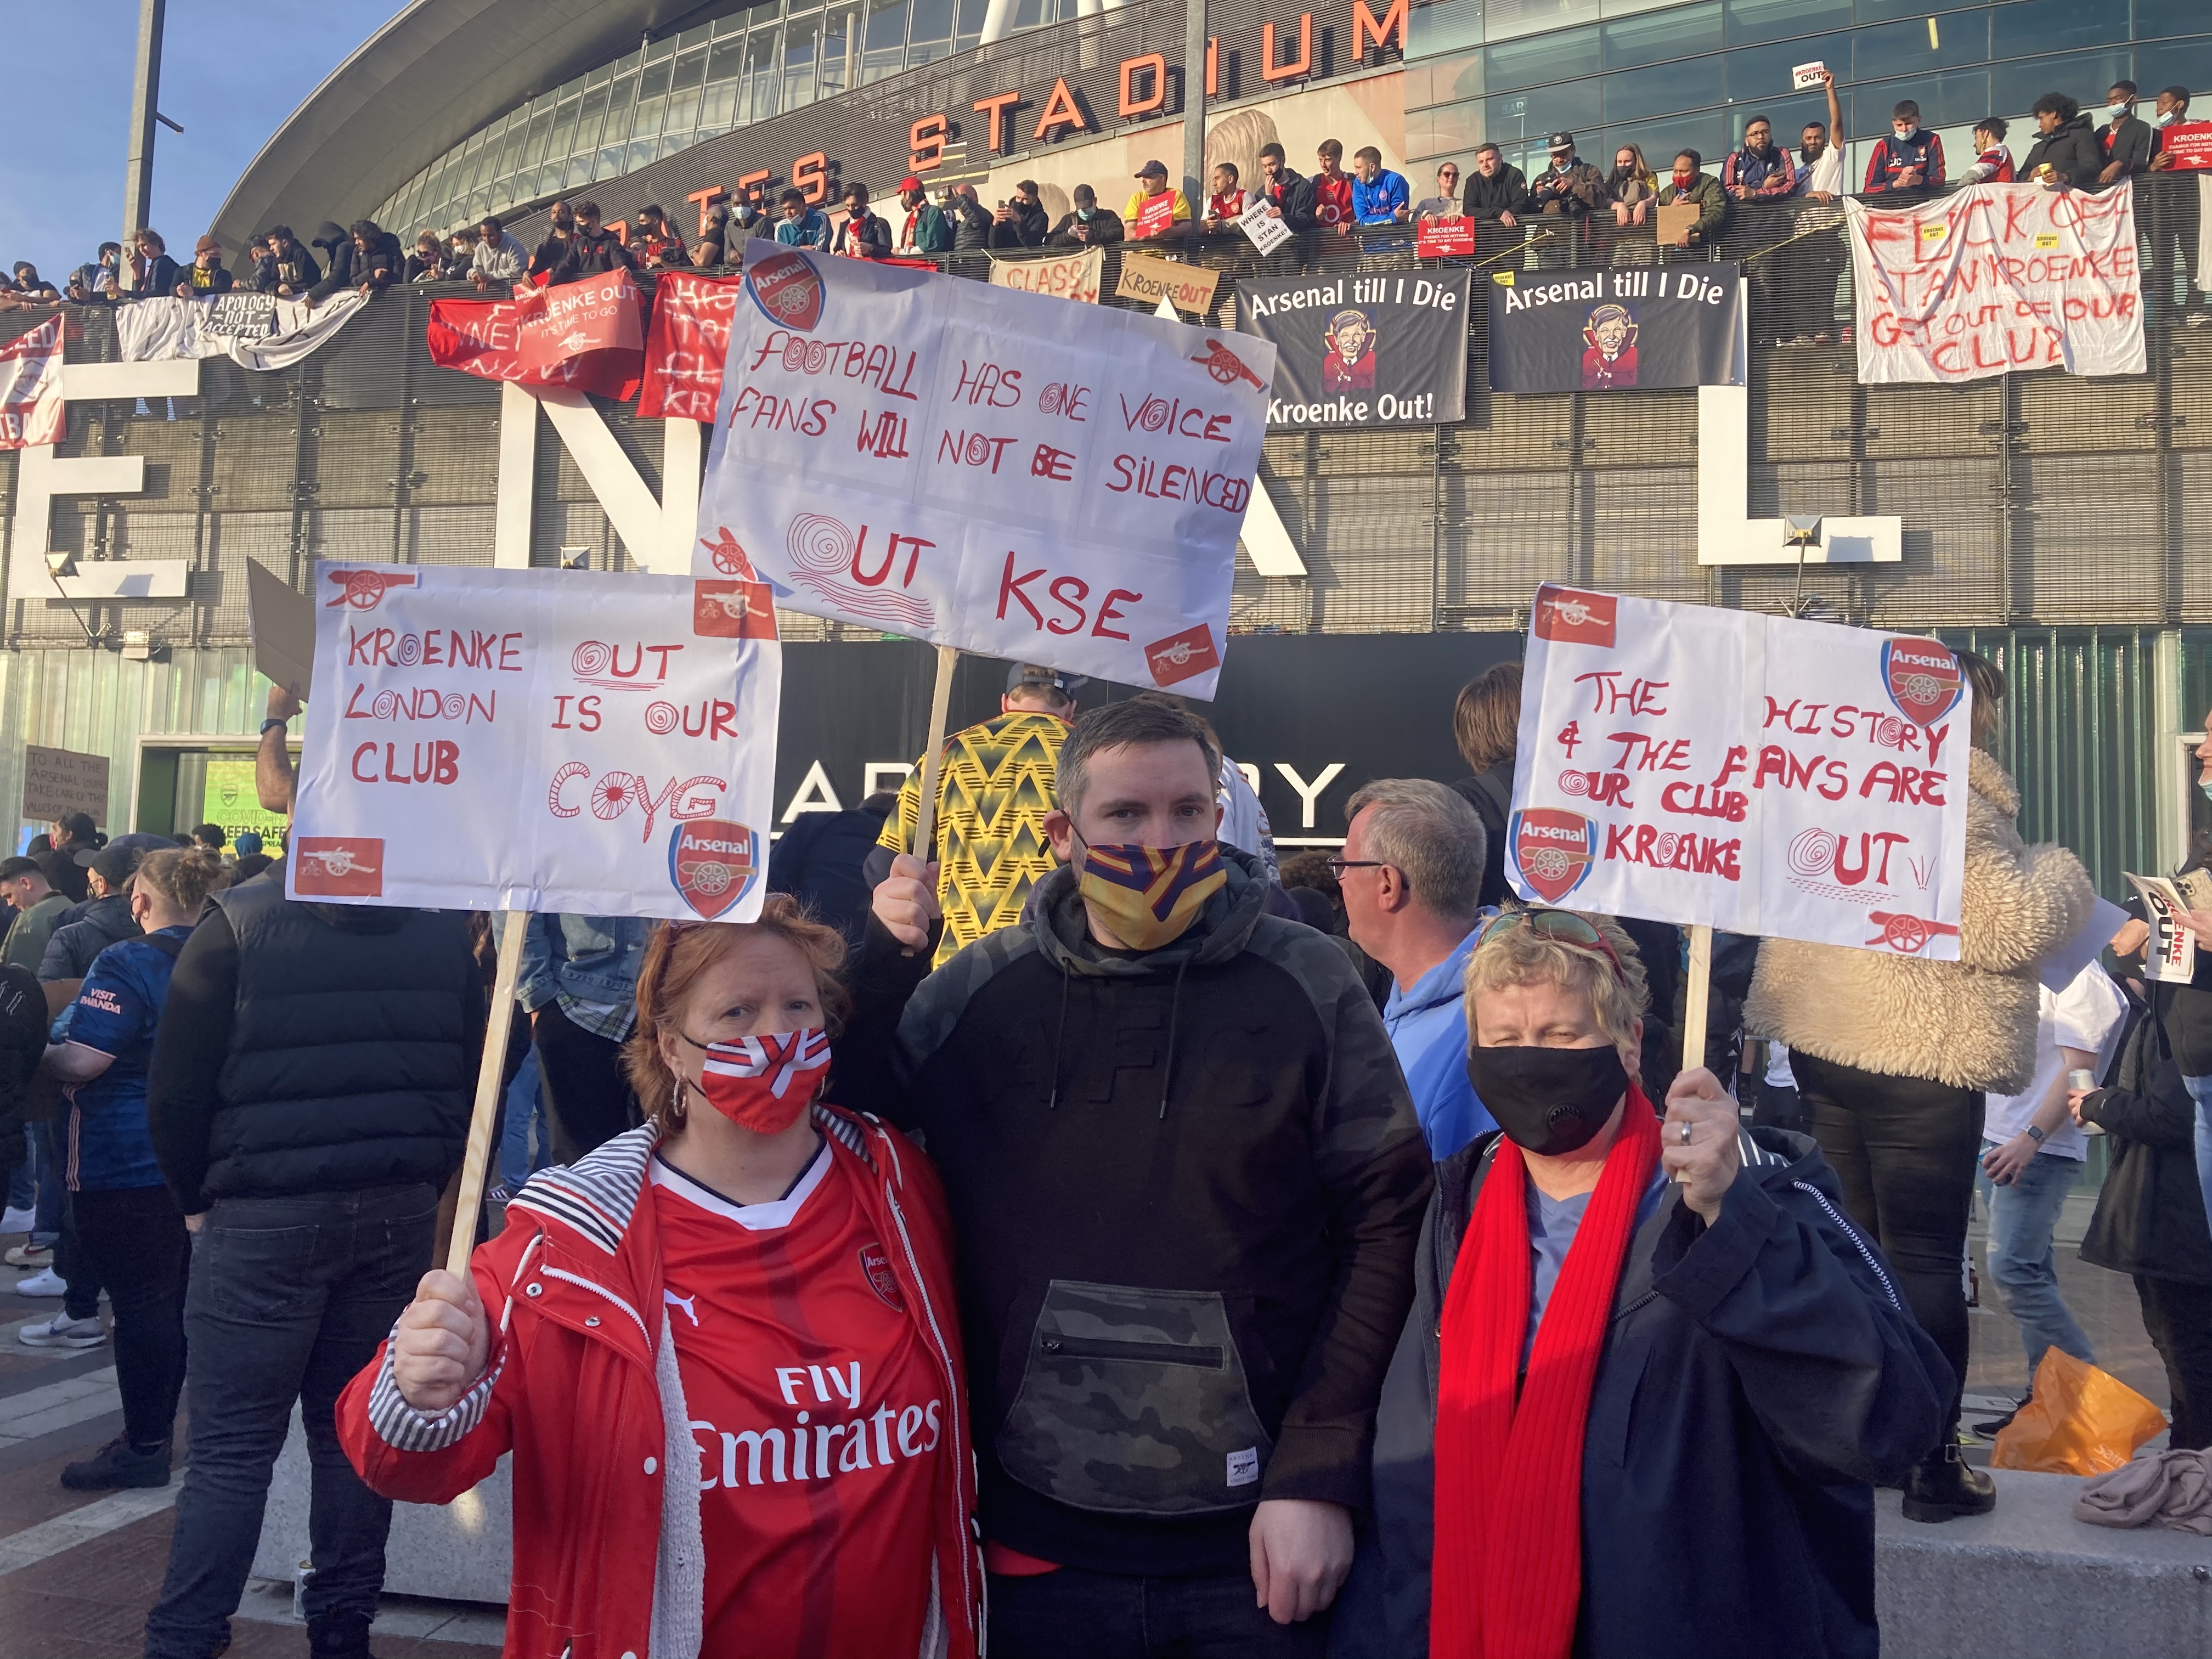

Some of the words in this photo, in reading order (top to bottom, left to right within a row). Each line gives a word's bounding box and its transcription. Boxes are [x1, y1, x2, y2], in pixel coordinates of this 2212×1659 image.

[909, 0, 1410, 172] STADIUM
[1801, 71, 1821, 82] OUT
[1145, 200, 1169, 215] KROENKE
[1240, 204, 1268, 227] WHERE
[1256, 221, 1266, 229] IS
[1257, 223, 1278, 241] STAN
[1259, 228, 1288, 252] KROENKE?
[1867, 195, 2036, 264] FUCK
[2050, 189, 2130, 238] OFF
[755, 259, 806, 291] Arsenal
[1007, 261, 1082, 293] CLASS
[1874, 259, 1979, 307] STAN
[1988, 246, 2134, 287] KROENKE
[215, 295, 275, 312] APOLOGY
[521, 291, 596, 328] KROENKE
[601, 285, 636, 301] OUT
[1252, 279, 1344, 320] Arsenal
[1353, 278, 1385, 303] till
[1396, 278, 1403, 304] I
[1412, 280, 1456, 311] Die
[1505, 273, 1603, 314] Arsenal
[1613, 271, 1648, 297] till
[1658, 272, 1667, 297] I
[1677, 273, 1724, 304] Die
[203, 321, 269, 336] ACCEPTED
[224, 310, 256, 324] NOT
[541, 324, 558, 338] IT'S
[558, 314, 580, 330] TIME
[582, 310, 597, 321] TO
[600, 305, 618, 317] GO
[1871, 312, 1937, 347] GET
[1944, 305, 2002, 335] OUT
[2016, 301, 2051, 319] OF
[2063, 293, 2136, 321] OUR
[1933, 325, 2064, 373] CLUB
[751, 330, 918, 401] FOOTBALL
[952, 359, 1022, 408] HAS
[1039, 382, 1092, 422] ONE
[1119, 392, 1232, 442] VOICE
[1265, 396, 1368, 424] Kroenke
[1378, 392, 1433, 421] Out!
[729, 386, 836, 437] FANS
[857, 409, 909, 458] WILL
[938, 430, 1019, 475] NOT
[1032, 443, 1076, 482] BE
[787, 512, 936, 589] OUT
[995, 550, 1143, 641] KSE
[348, 624, 523, 672] KROENKE
[572, 640, 684, 680] OUT
[1891, 647, 1956, 672] Arsenal
[345, 683, 497, 725] LONDON
[551, 695, 602, 731] IS
[645, 698, 739, 741] OUR
[1574, 671, 1669, 716] THE
[1762, 695, 1950, 768] HISTORY
[28, 752, 47, 766] TO
[55, 757, 75, 769] ALL
[81, 761, 103, 774] THE
[30, 768, 80, 786] ARSENAL
[1607, 732, 1691, 771] THE
[1711, 744, 1848, 801] FANS
[1859, 761, 1949, 807] ARE
[25, 800, 52, 812] VALUES
[52, 804, 64, 814] OF
[26, 782, 54, 798] TAKE
[55, 787, 74, 799] CARE
[87, 792, 106, 803] THE
[351, 740, 460, 785] CLUB
[549, 761, 727, 844] COYG
[1558, 769, 1633, 810] OUR
[1661, 781, 1748, 822] CLUB
[217, 809, 287, 825] COVID-19
[1520, 820, 1586, 843] Arsenal
[680, 833, 750, 857] Arsenal
[1604, 823, 1741, 882] KROENKE
[2148, 891, 2173, 963] OUT
[80, 995, 121, 1015] RWANDA
[91, 988, 116, 1002] VISIT
[867, 1256, 887, 1267] Arse
[775, 1361, 860, 1409] Fly
